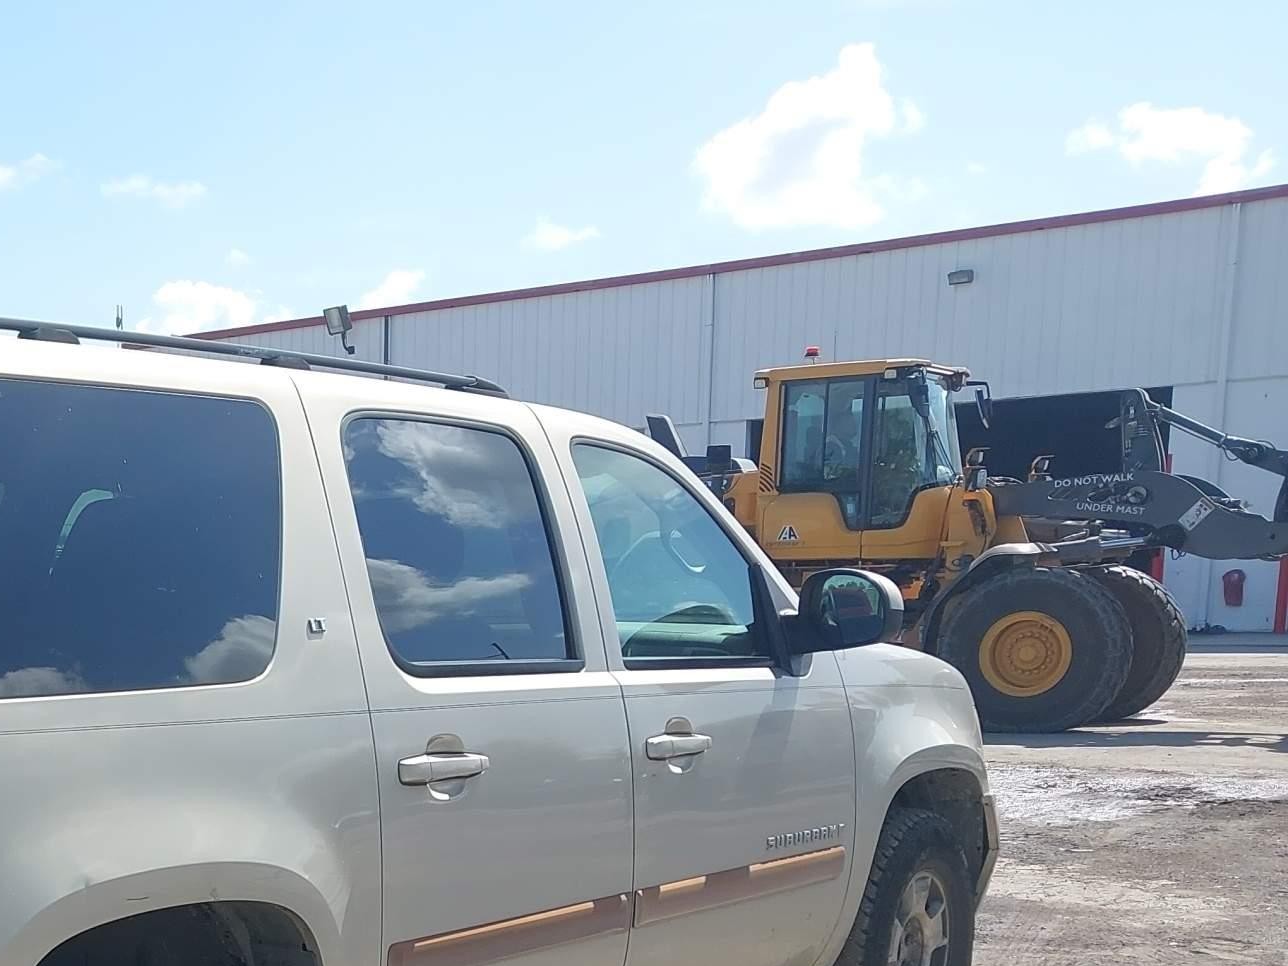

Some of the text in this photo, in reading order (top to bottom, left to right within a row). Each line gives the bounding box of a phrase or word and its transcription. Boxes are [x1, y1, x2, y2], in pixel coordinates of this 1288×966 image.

[1054, 473, 1134, 488] DO NOT WALK
[1076, 502, 1146, 515] UNDER MAST
